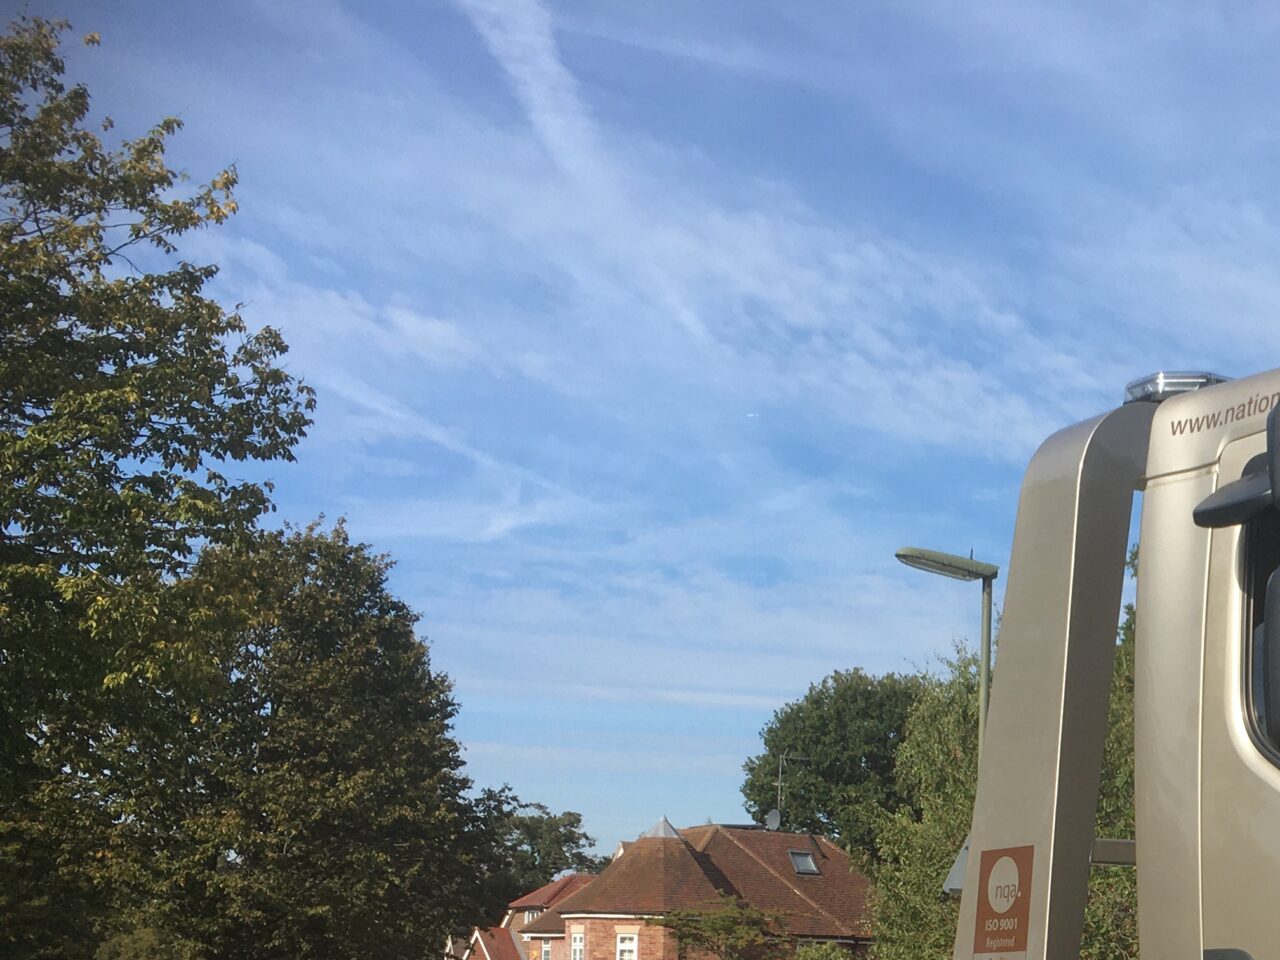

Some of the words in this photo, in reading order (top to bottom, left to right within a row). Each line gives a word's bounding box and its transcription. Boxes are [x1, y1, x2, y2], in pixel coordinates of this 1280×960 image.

[985, 918, 999, 931] ISO
[1000, 917, 1018, 930] 9001
[986, 935, 1015, 951] Registered
